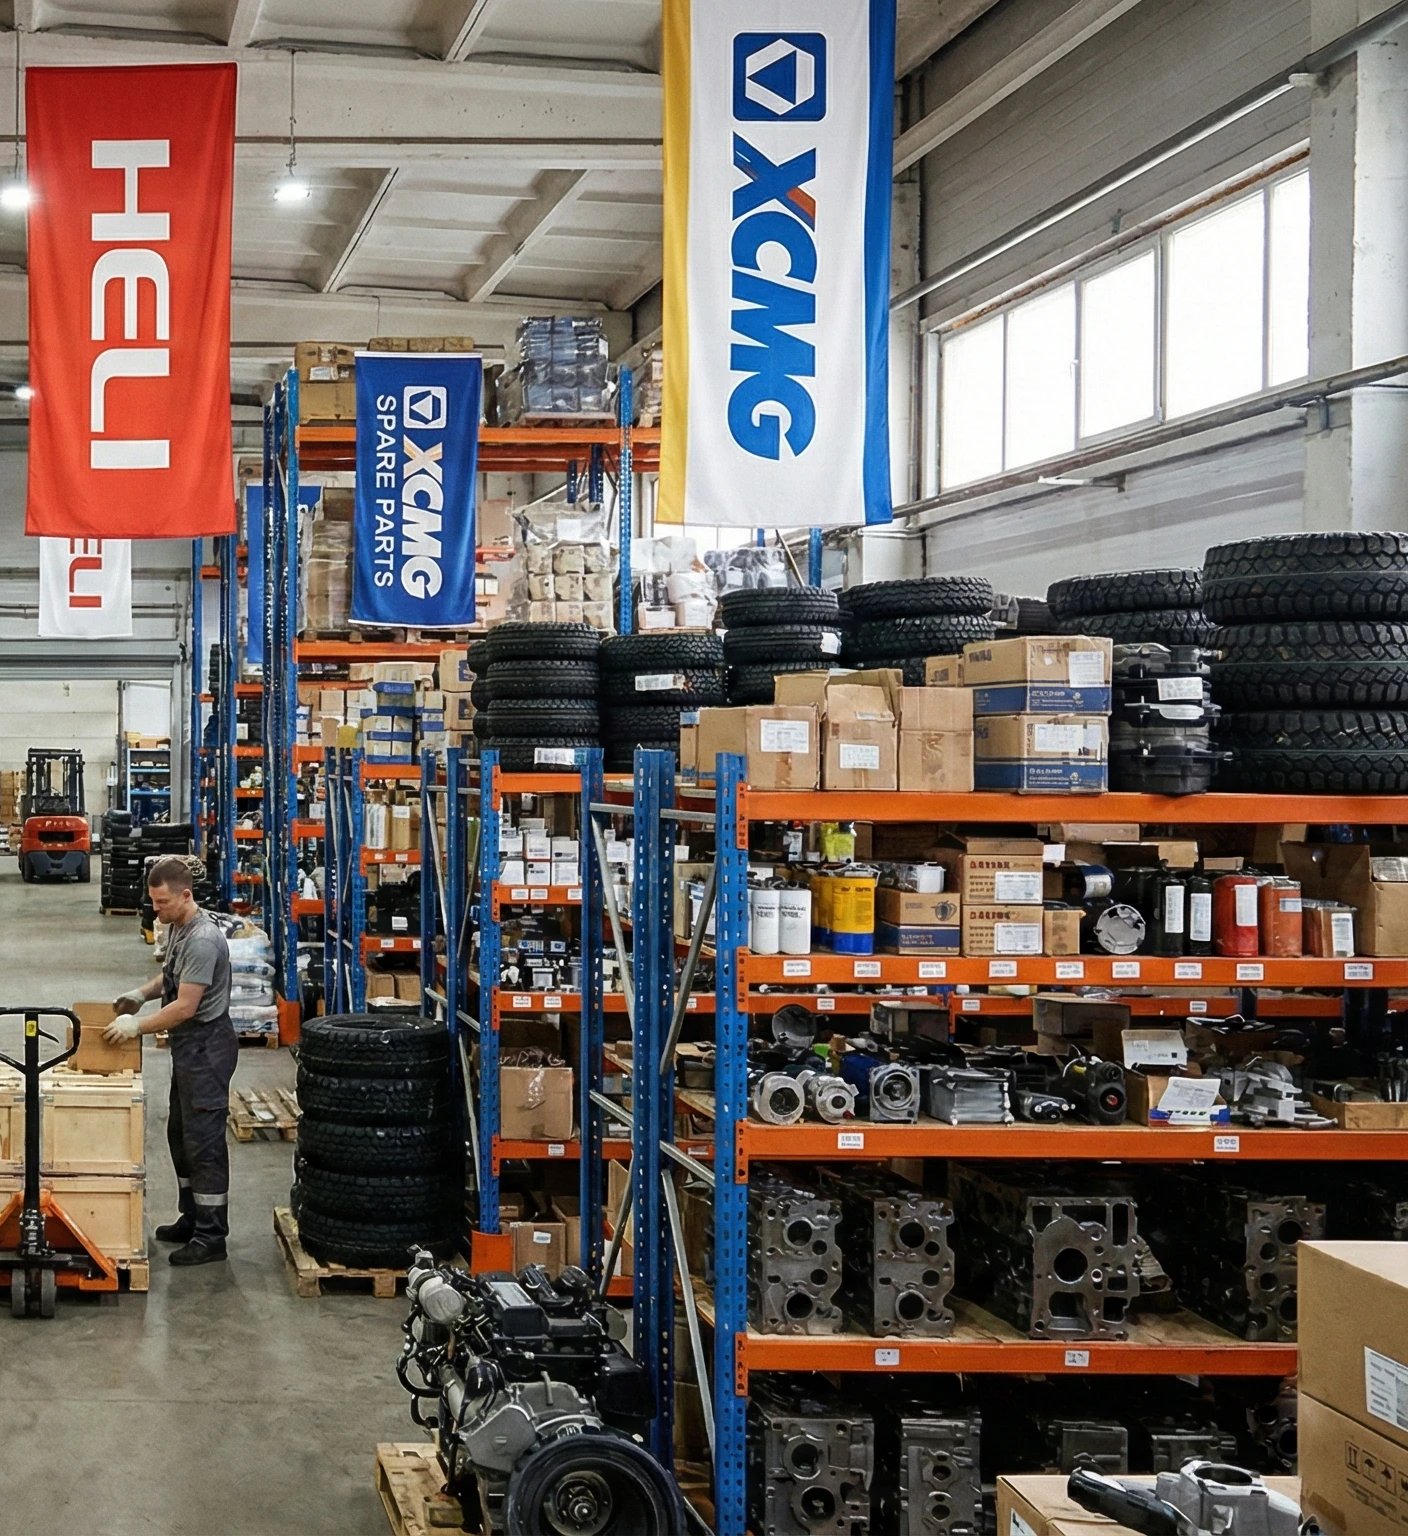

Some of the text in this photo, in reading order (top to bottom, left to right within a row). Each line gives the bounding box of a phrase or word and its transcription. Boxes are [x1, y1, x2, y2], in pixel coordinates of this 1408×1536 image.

[91, 138, 171, 470] HELI
[726, 131, 819, 462] XCMG
[373, 394, 396, 587] SPARE PARTS
[400, 434, 444, 599] XCMG
